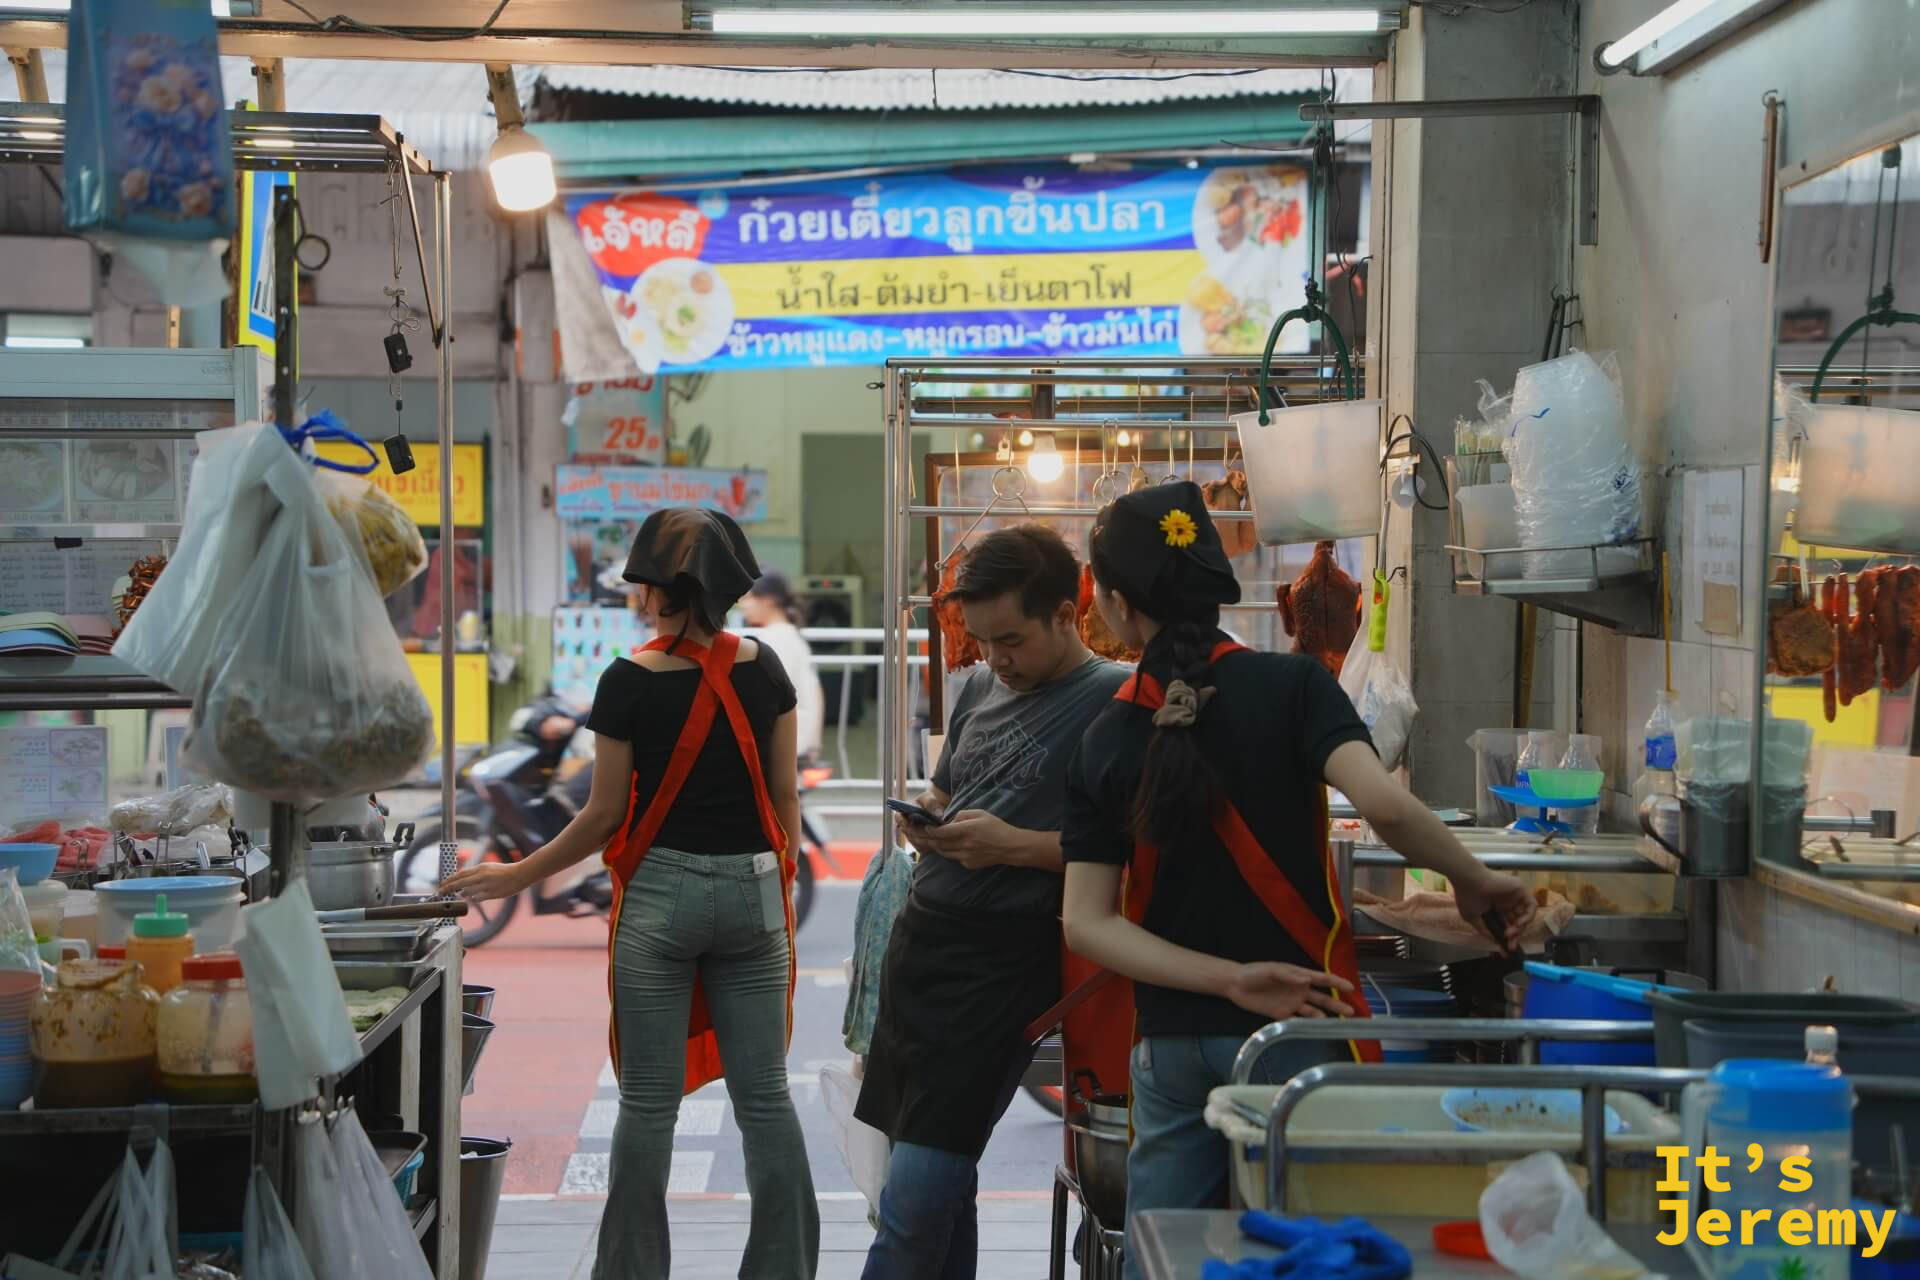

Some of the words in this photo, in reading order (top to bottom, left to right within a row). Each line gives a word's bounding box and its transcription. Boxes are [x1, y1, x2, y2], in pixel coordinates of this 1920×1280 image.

[737, 176, 1166, 253] ก๋วยเตี๋ยวลูกชิ้นปลา
